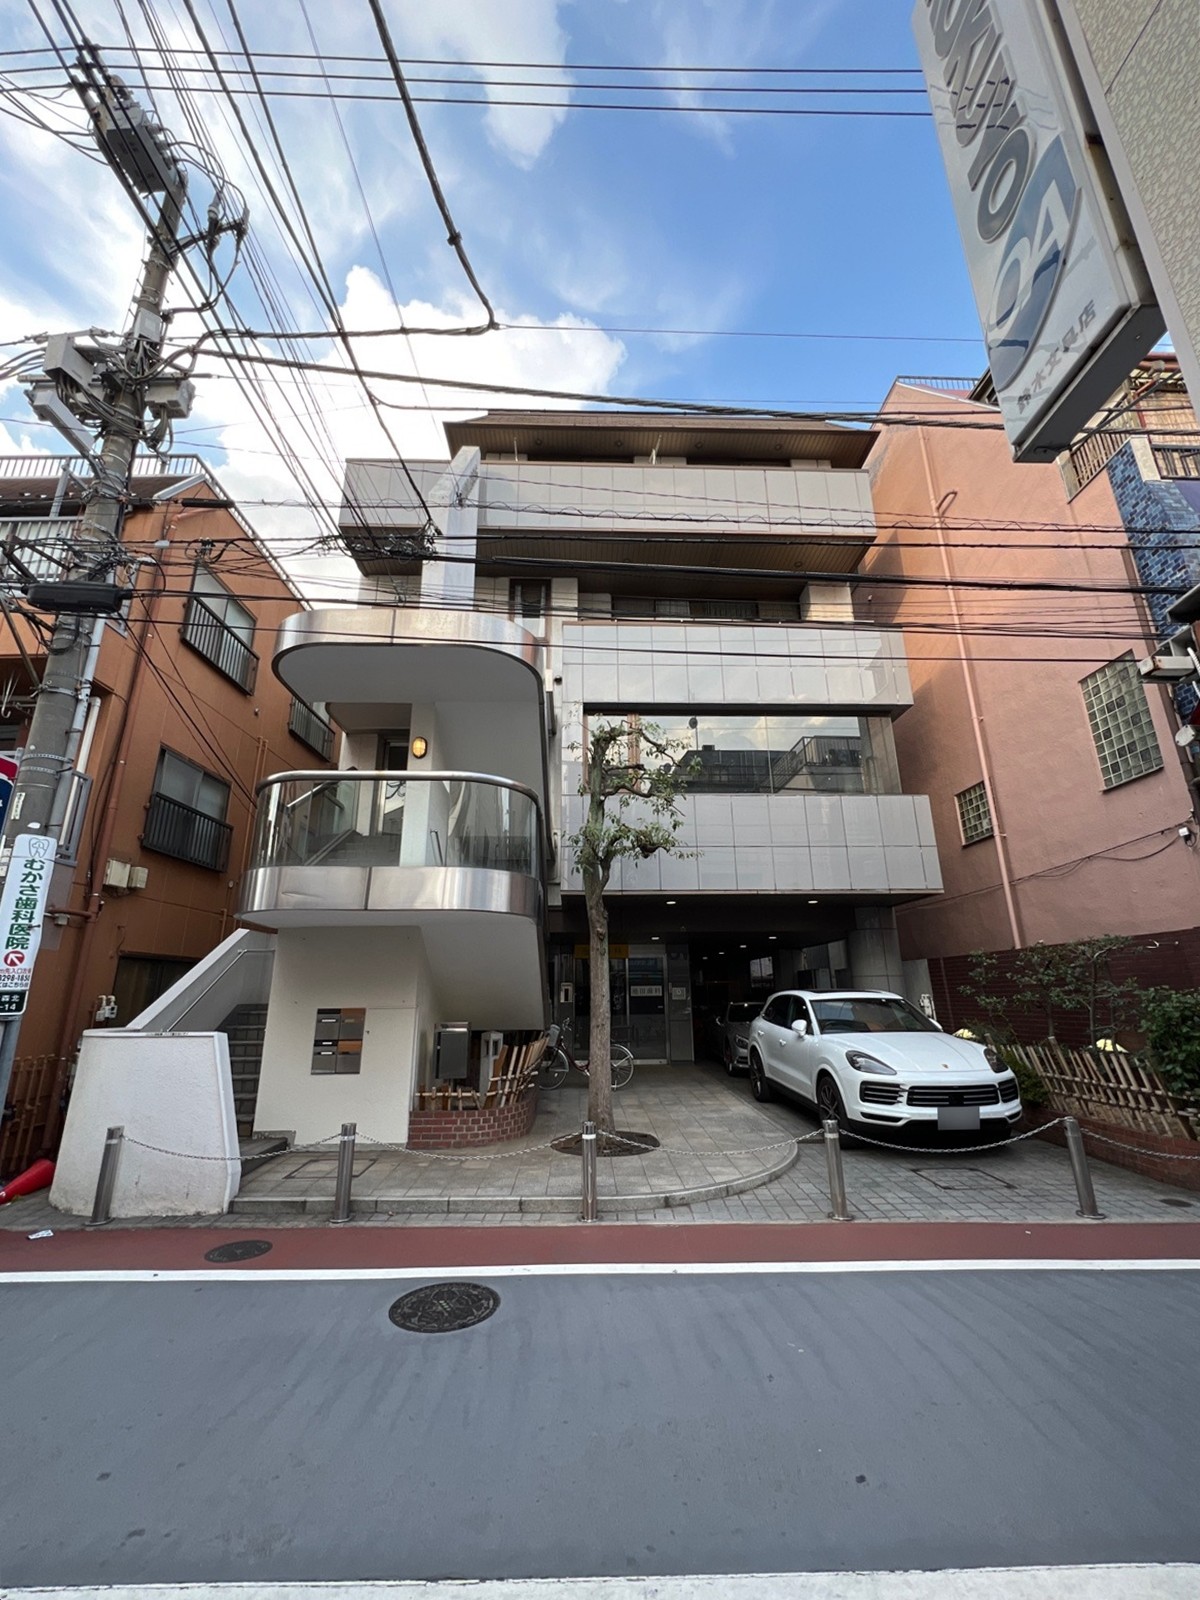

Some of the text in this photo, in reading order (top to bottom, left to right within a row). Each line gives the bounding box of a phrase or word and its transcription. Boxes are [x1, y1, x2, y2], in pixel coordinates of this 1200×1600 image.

[926, 0, 1032, 243] OKUYO
[1017, 299, 1096, 415] 鈴木文具店
[5, 858, 45, 950] むかさ歯科医院
